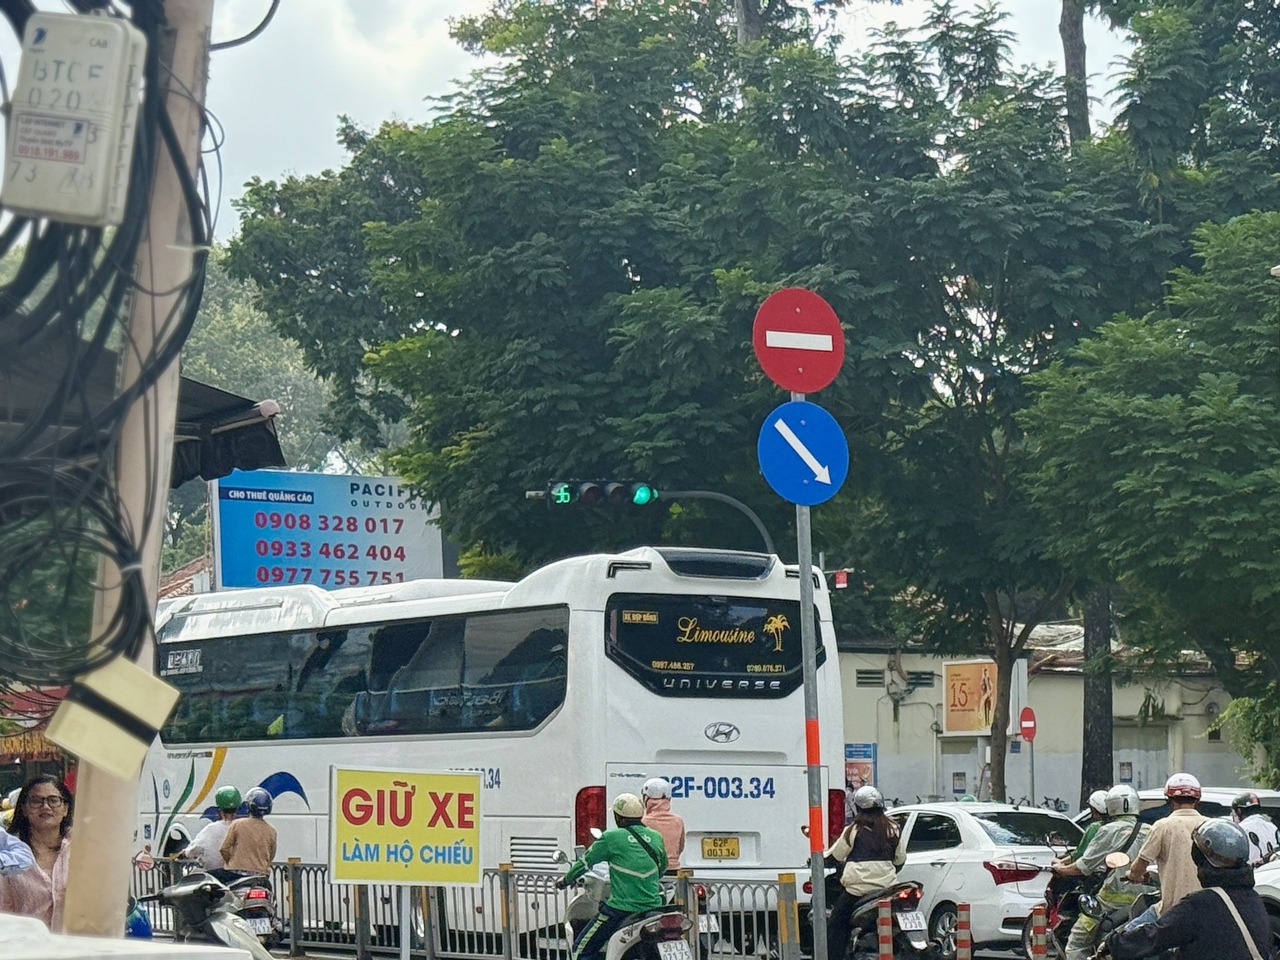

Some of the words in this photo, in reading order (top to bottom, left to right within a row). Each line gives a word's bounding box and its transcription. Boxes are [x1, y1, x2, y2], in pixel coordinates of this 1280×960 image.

[89, 38, 108, 48] CAB
[18, 144, 80, 161] 0918.191.989
[228, 490, 245, 499] CHO
[246, 490, 267, 500] THUÊ
[268, 491, 296, 502] QUẢNG
[297, 493, 313, 503] CÁO
[351, 499, 428, 511] OUTDOOR
[255, 511, 311, 530] 0908
[318, 515, 358, 533] 328
[365, 517, 404, 534] 017
[256, 540, 311, 558] 0933
[319, 543, 359, 560] 462
[366, 545, 406, 562] 404
[257, 566, 312, 583] 0977
[320, 569, 360, 586] 755
[366, 571, 404, 586] 751
[677, 616, 756, 644] Limousine
[663, 678, 781, 690] UNIVERSE
[950, 682, 968, 707] 15
[659, 776, 775, 798] 2F-003.34
[342, 781, 416, 827] GIỮ
[427, 792, 474, 829] XE
[342, 837, 379, 862] LÀM
[386, 839, 414, 869] HỘ
[420, 838, 473, 865] CHIẾU
